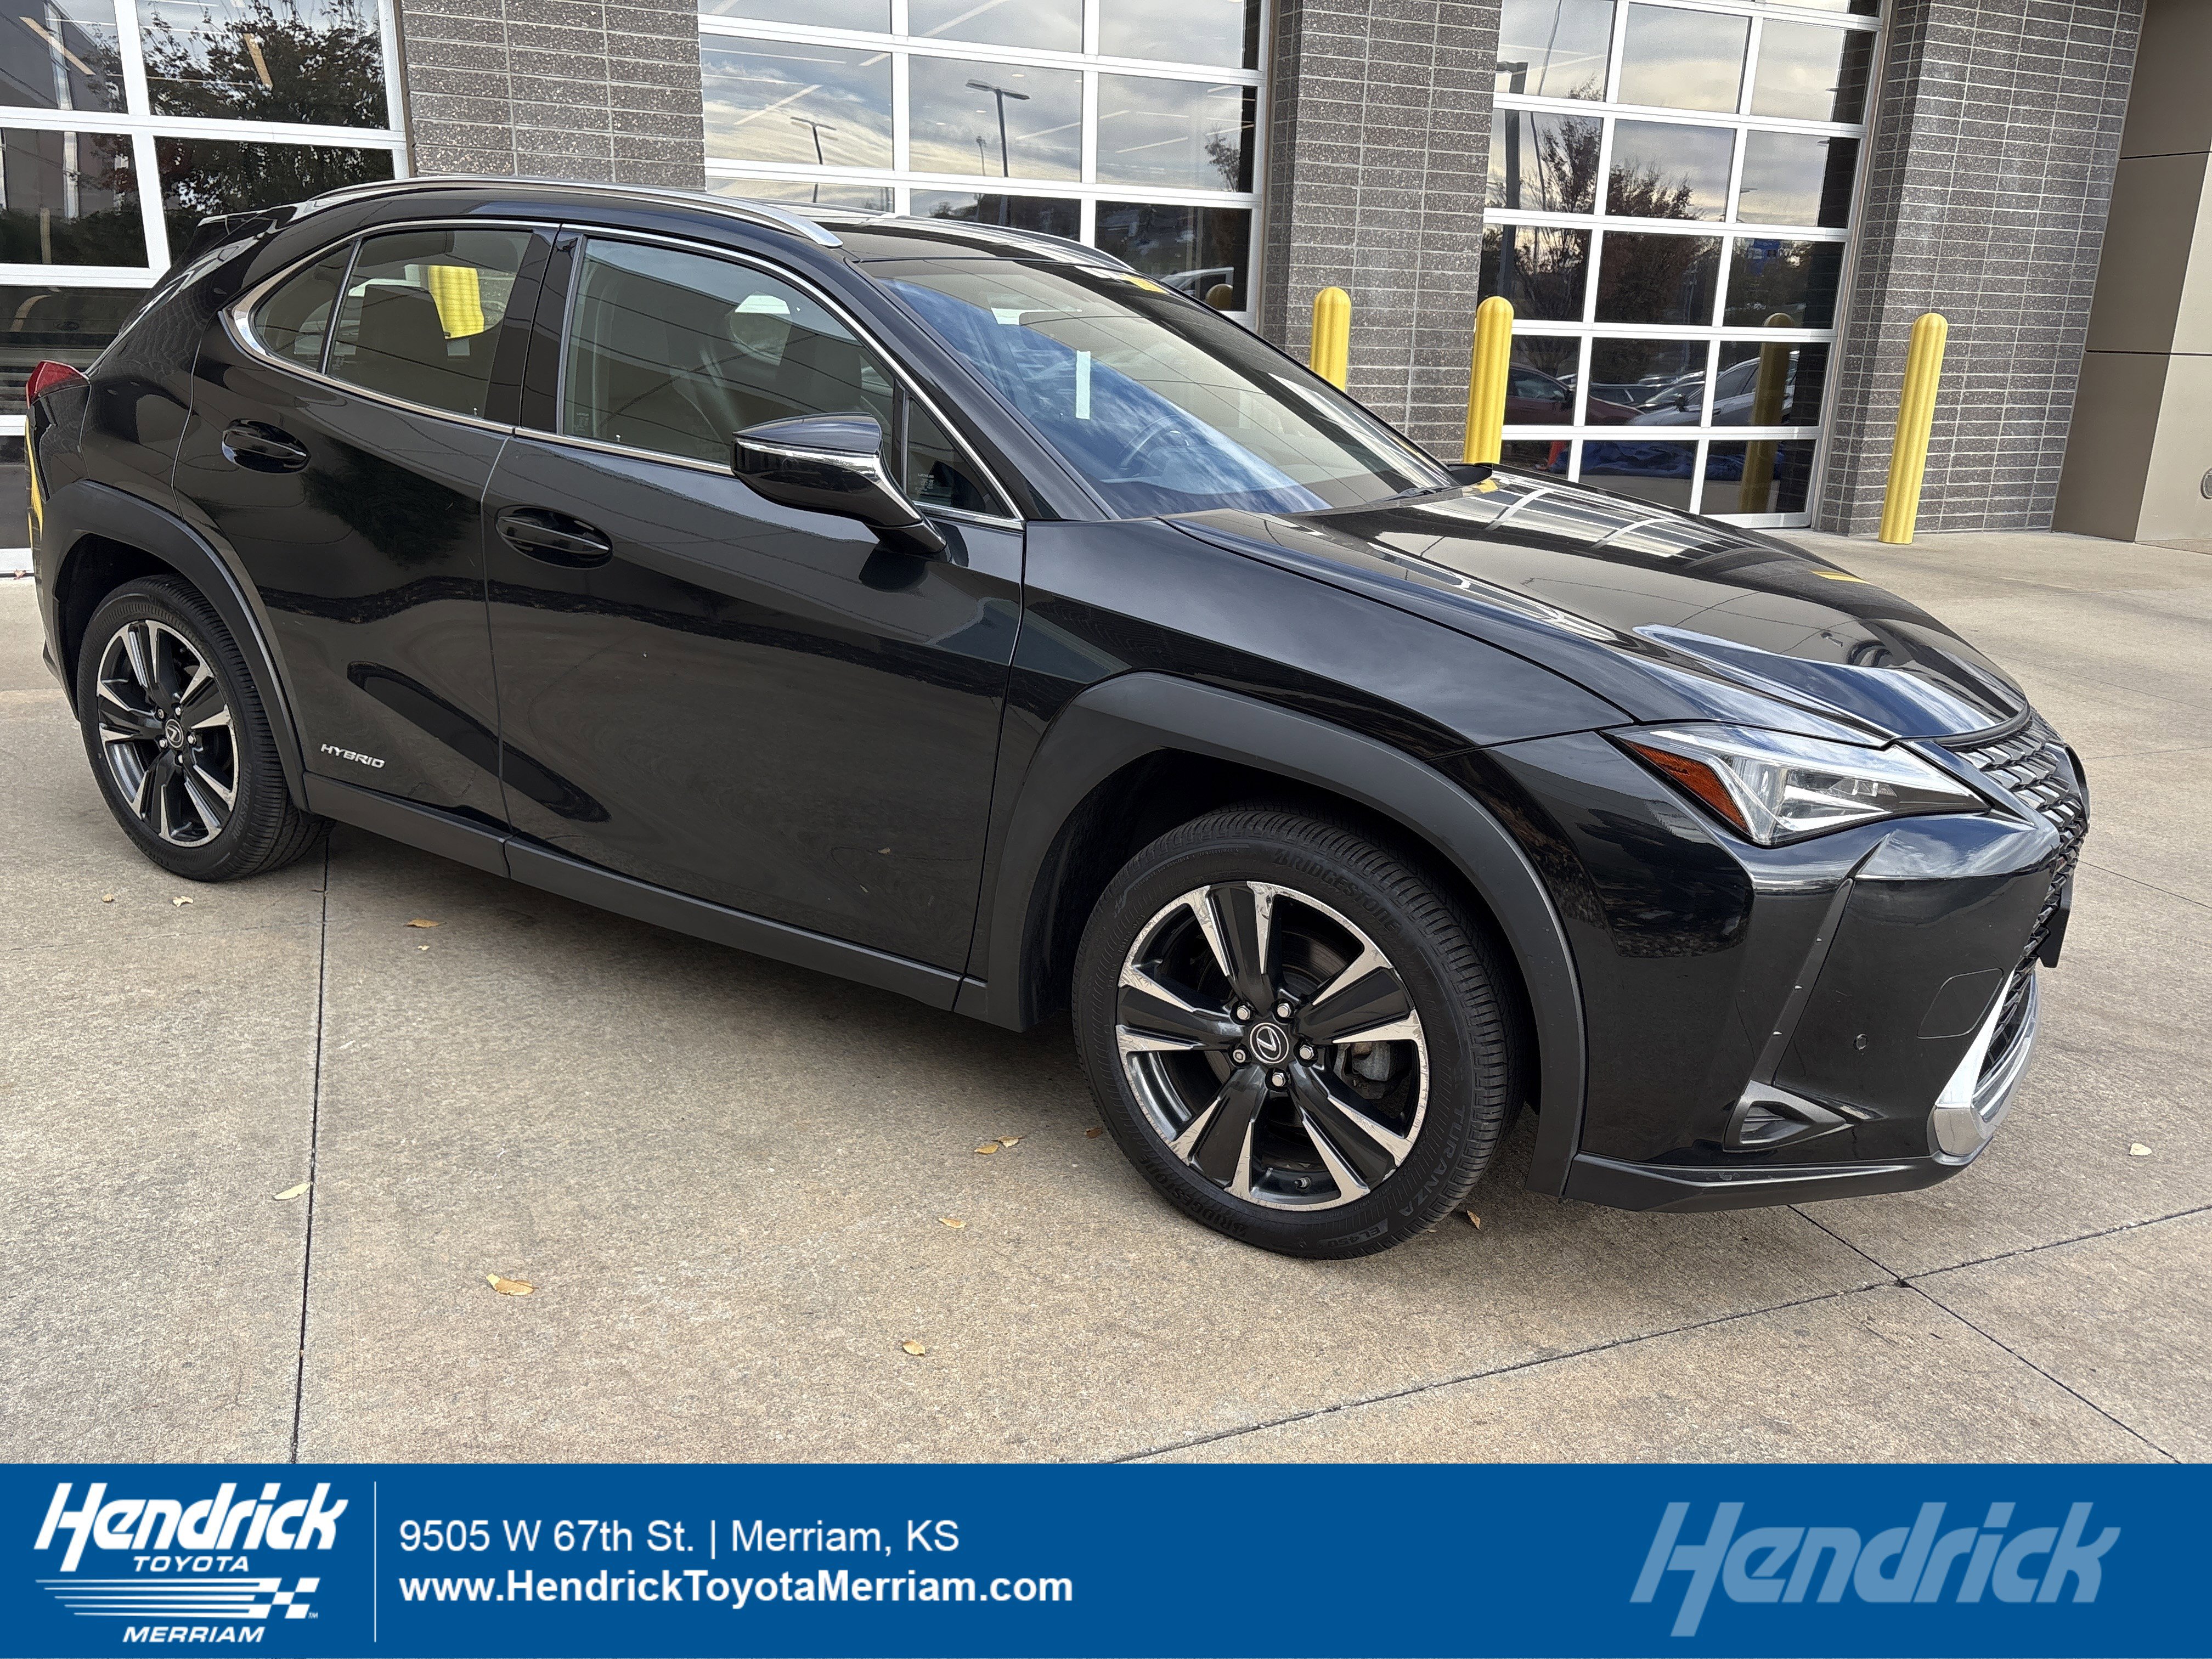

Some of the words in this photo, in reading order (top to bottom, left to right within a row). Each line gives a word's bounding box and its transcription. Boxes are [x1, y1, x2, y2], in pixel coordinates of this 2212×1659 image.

[320, 743, 385, 769] HYBRID
[1271, 849, 1403, 933] BRIDGESTONE
[1399, 1105, 1465, 1217] TURANZA
